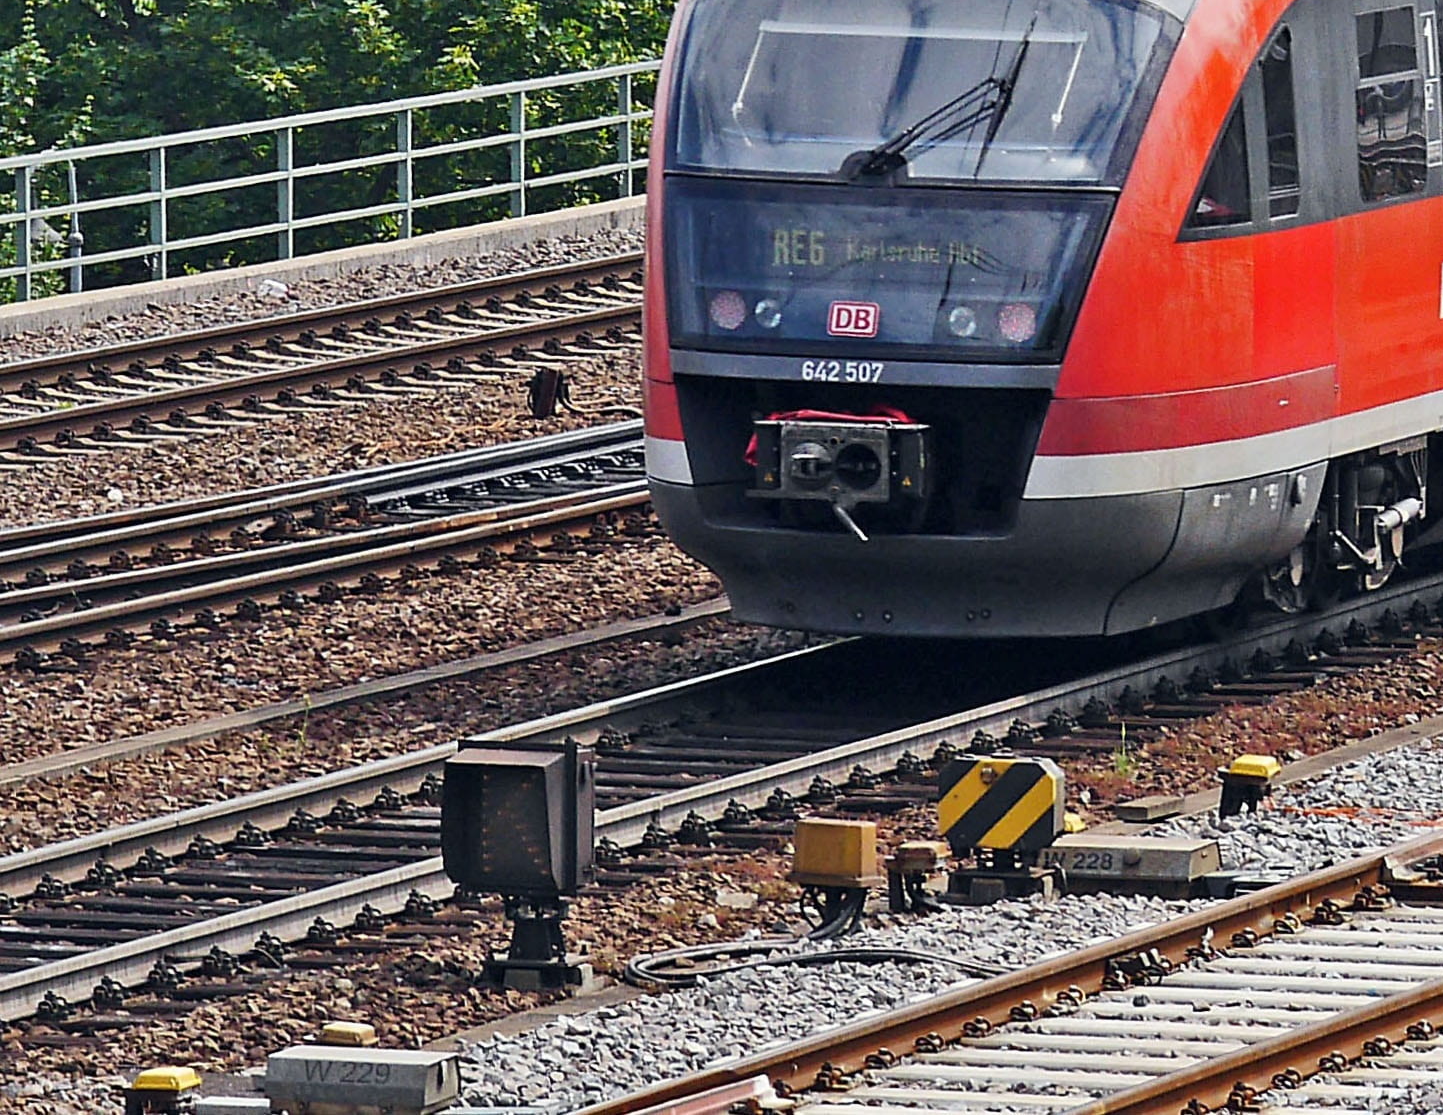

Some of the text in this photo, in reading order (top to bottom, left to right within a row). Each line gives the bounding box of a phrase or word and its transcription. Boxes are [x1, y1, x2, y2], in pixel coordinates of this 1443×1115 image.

[1423, 17, 1435, 77] 1
[772, 229, 825, 267] RE6
[802, 360, 884, 383] 642 507
[1043, 851, 1113, 870] W 228
[304, 1059, 391, 1085] W 229
